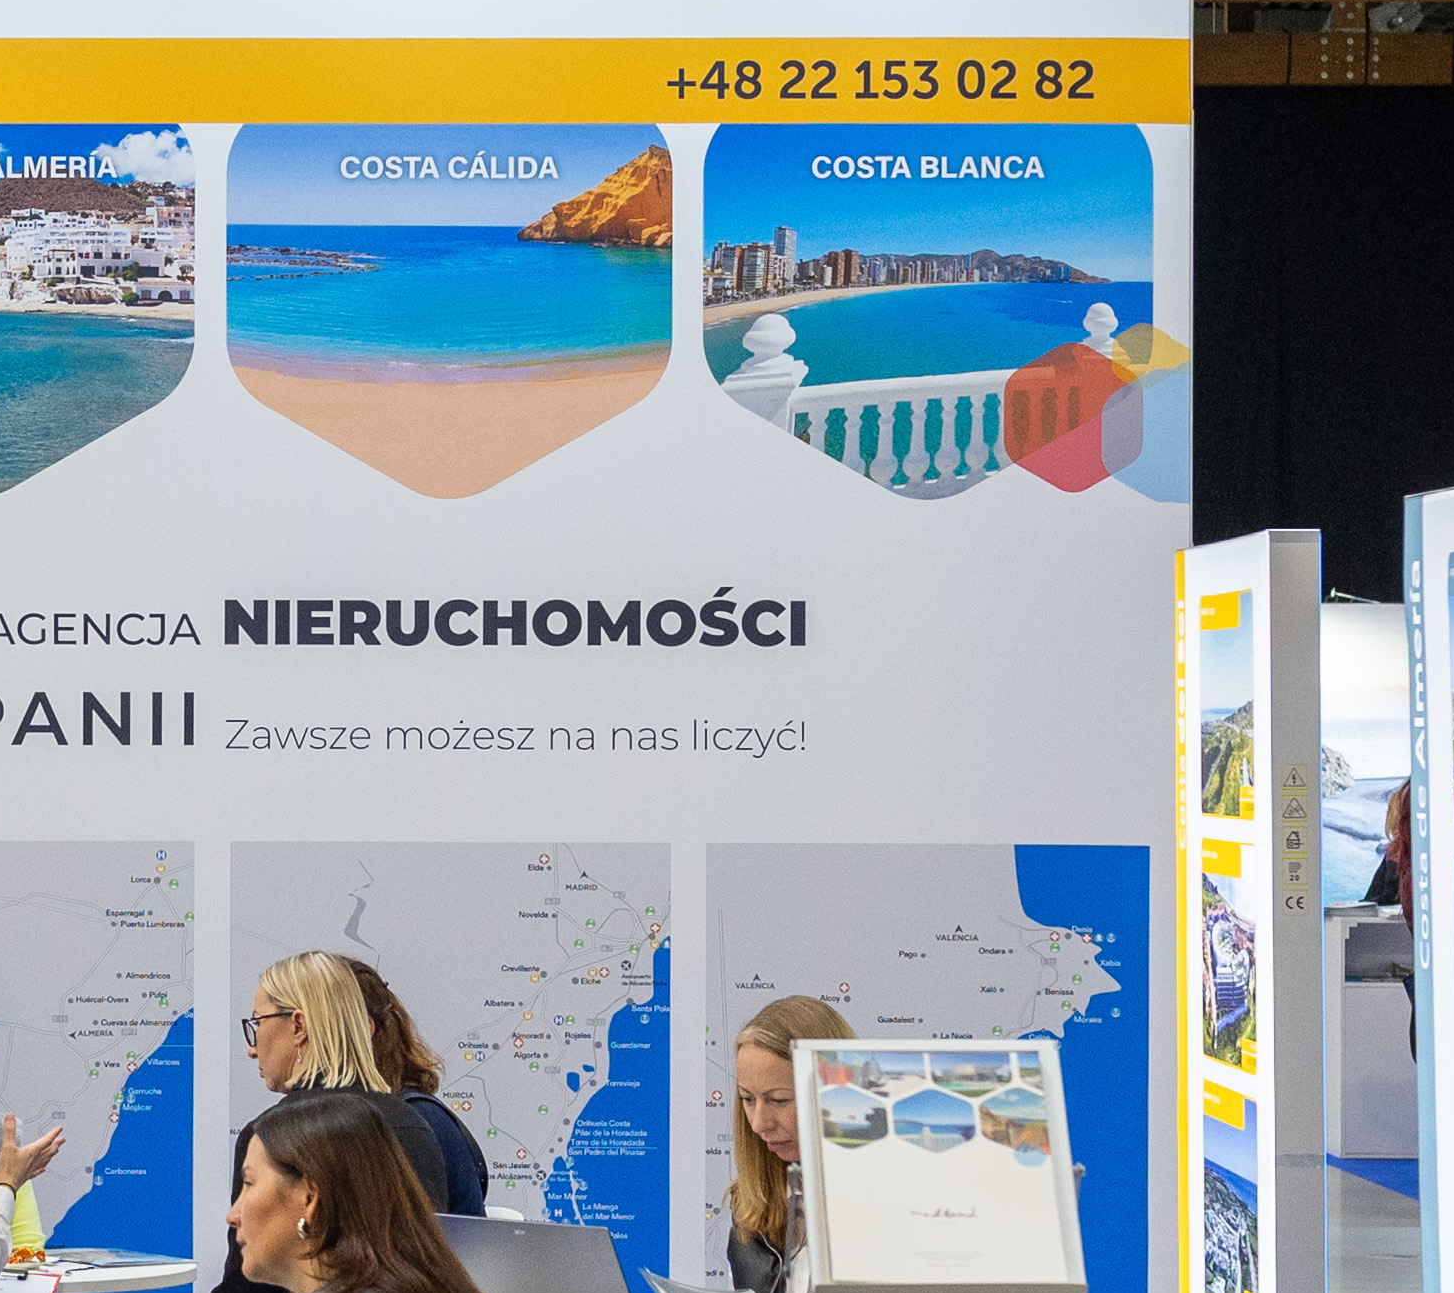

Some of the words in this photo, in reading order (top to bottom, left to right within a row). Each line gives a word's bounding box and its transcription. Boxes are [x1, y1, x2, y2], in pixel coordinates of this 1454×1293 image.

[667, 60, 762, 100] +48
[779, 60, 838, 100] 22
[855, 60, 940, 100] 153
[956, 60, 1018, 100] 02
[1035, 60, 1095, 100] 82
[339, 156, 440, 180] COSTA
[445, 149, 559, 180] CÁLIDA
[811, 156, 914, 180] COSTA
[919, 156, 1045, 180] BLANCA
[224, 586, 807, 647] NIERUCHOMOŚCI
[1410, 560, 1426, 770] Almería
[225, 719, 371, 751] Zawsze
[386, 719, 535, 751] możesz
[550, 726, 596, 751] na
[612, 726, 678, 751] nas
[693, 718, 808, 759] liczyć!
[1417, 786, 1427, 838] de
[131, 876, 151, 884] Lorca
[106, 909, 145, 918] Esparragal
[519, 911, 548, 919] Novelda
[1419, 852, 1431, 971] Costa
[120, 920, 145, 928] Puerto
[146, 920, 185, 928] Lumbreras
[935, 933, 979, 942] VALENCIA
[898, 950, 918, 959] Pego
[978, 947, 1006, 955] Ondara
[125, 971, 171, 979] Almendricos
[580, 977, 601, 986] Elche
[735, 982, 775, 990] VALENCIA
[1045, 988, 1075, 996] Benissa
[76, 995, 130, 1004] Huércal-Overa
[484, 999, 515, 1007] Albatera
[820, 994, 841, 1004] Alcoy
[101, 1019, 127, 1027] Cuevas
[129, 1018, 138, 1027] de
[877, 1015, 915, 1024] Guadalest
[77, 1029, 114, 1038] ALMERÍA
[565, 1031, 592, 1040] Rojales
[940, 1032, 950, 1040] La
[458, 1041, 489, 1049] Orihuela
[514, 1051, 541, 1061] Algorfa
[127, 1087, 162, 1097] Garrucha
[443, 1092, 474, 1100] MURCIA
[576, 1119, 608, 1128] Orihuela
[610, 1119, 631, 1128] Costa
[575, 1129, 589, 1137] Pilar
[591, 1129, 599, 1137] de
[601, 1129, 607, 1137] la
[611, 1129, 648, 1137] Horadada
[610, 1138, 645, 1147] Horadada
[568, 1148, 582, 1156] San
[586, 1148, 606, 1156] Pedro
[608, 1148, 618, 1156] del
[620, 1148, 646, 1156] Pinatar
[493, 1161, 507, 1169] San
[509, 1161, 531, 1169] Javier
[104, 1167, 147, 1176] Carboneras
[496, 1171, 533, 1180] Alcázares
[548, 1192, 564, 1201] Mar
[582, 1203, 591, 1211] La
[593, 1203, 618, 1212] Manga
[595, 1212, 609, 1221] Mar
[611, 1212, 635, 1221] Menor
